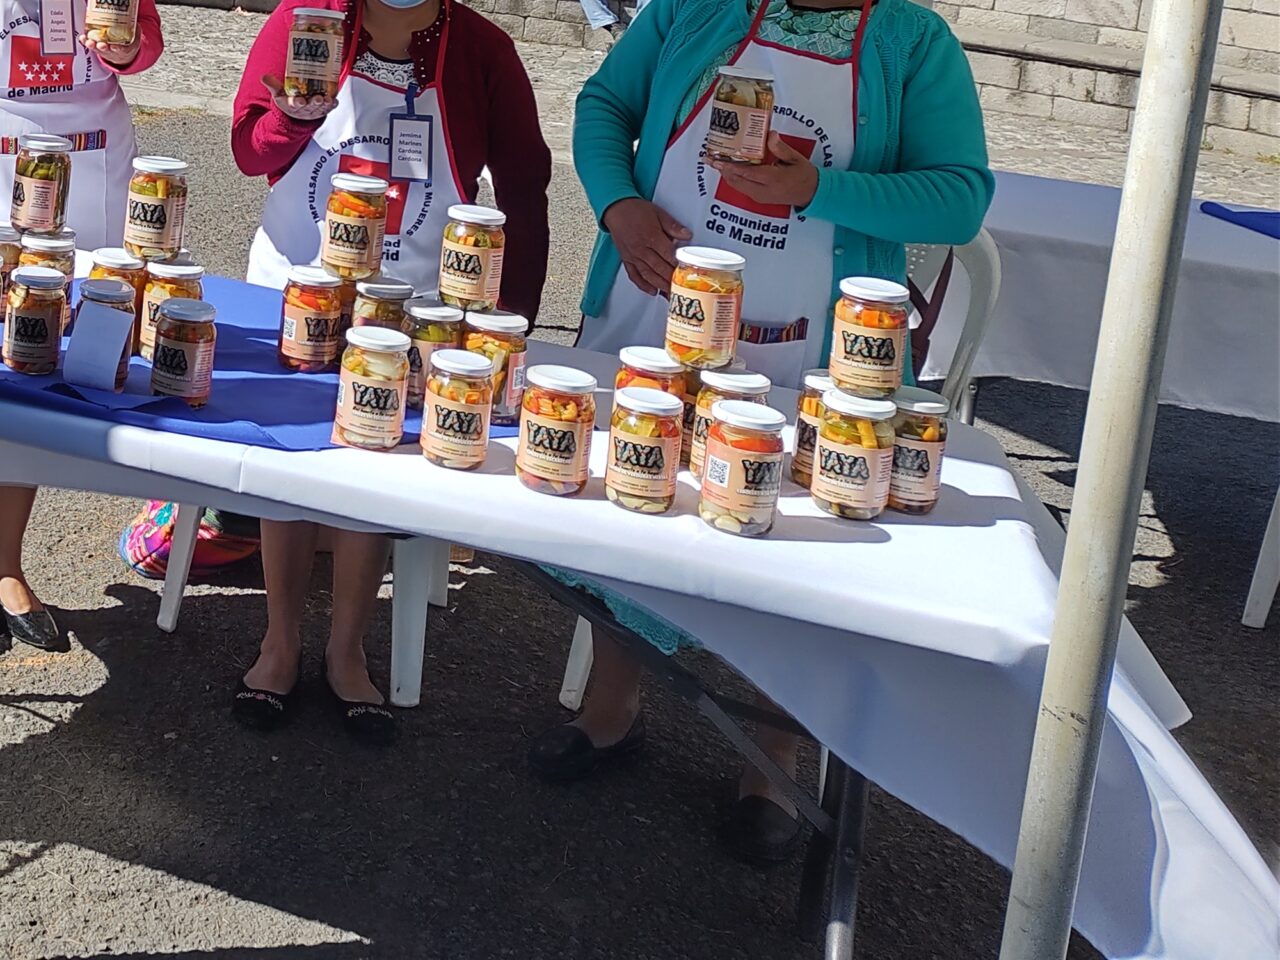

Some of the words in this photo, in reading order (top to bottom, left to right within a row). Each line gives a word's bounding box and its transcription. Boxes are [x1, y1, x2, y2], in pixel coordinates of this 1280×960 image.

[7, 87, 25, 98] de
[814, 126, 829, 143] DE
[822, 144, 833, 168] LAS
[308, 155, 327, 224] IMPULSANDO
[326, 146, 340, 157] EL
[340, 135, 390, 149] DESARRO
[406, 192, 433, 237] MUJERES
[710, 204, 789, 235] Comunidad
[329, 219, 369, 245] YAYA
[706, 218, 725, 234] de
[728, 225, 786, 250] Madrid
[842, 331, 895, 359] YAYA
[352, 381, 399, 410] YAYA
[435, 405, 483, 435] YAYA
[527, 419, 576, 453] YAYA
[614, 436, 664, 469] YAYA
[820, 445, 869, 479] YAYA
